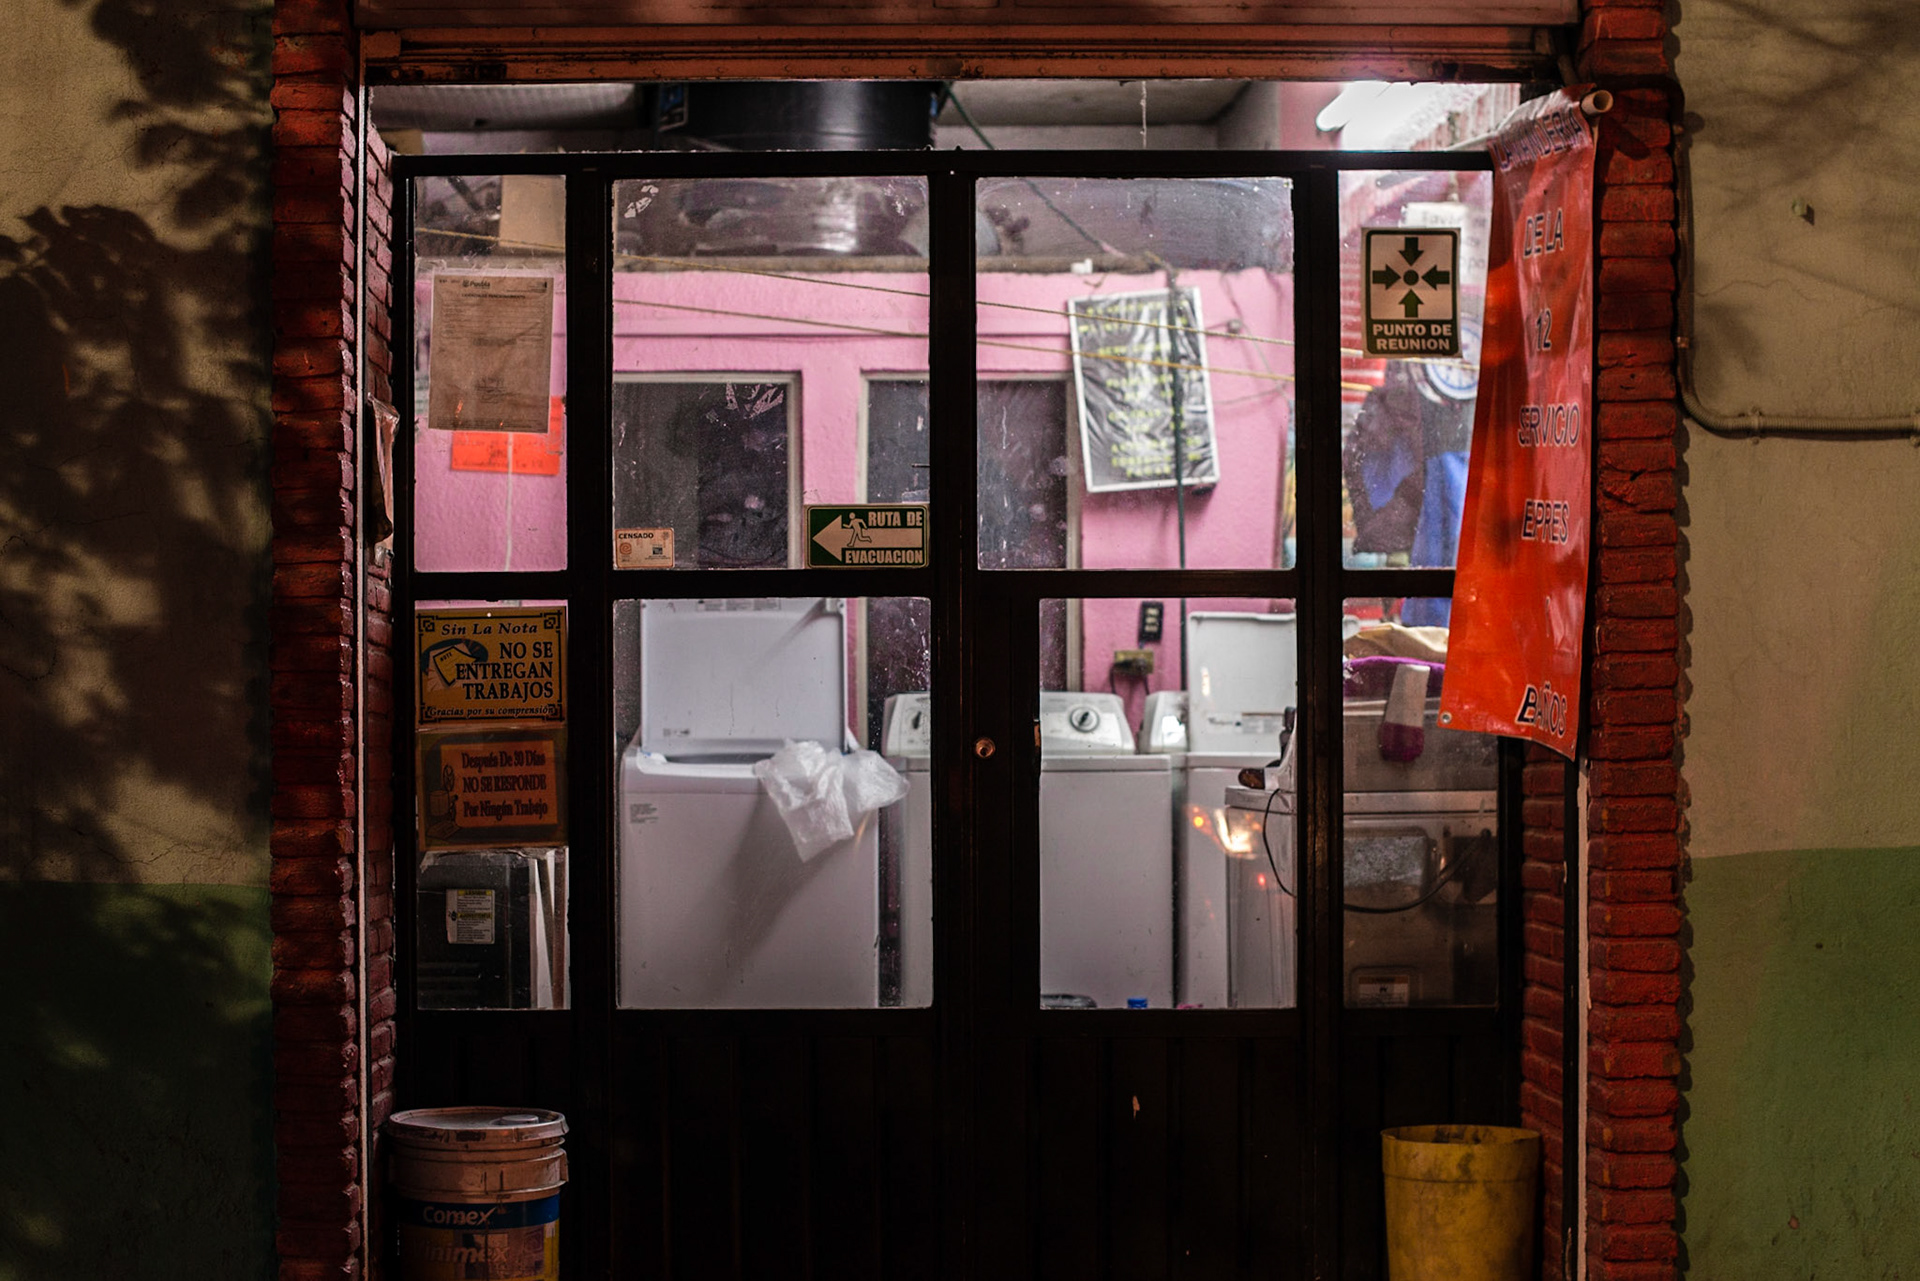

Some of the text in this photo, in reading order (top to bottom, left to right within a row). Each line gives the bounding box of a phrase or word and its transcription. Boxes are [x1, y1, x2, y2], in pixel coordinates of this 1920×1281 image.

[1545, 208, 1564, 252] LA
[1372, 323, 1453, 337] PUNTO DE
[1536, 308, 1553, 351] 12
[1376, 338, 1450, 350] REUNION
[867, 511, 924, 527] RUTA DE
[618, 532, 654, 540] CENSADO
[844, 549, 924, 564] EVACUACION
[441, 622, 538, 635] Sin La Nota
[499, 641, 553, 659] NO SE
[455, 662, 553, 680] ENTREGAN
[462, 681, 554, 703] TRABAJOS
[430, 707, 464, 717] Gracias
[467, 709, 482, 719] por
[498, 705, 555, 718] comprensión
[1514, 680, 1567, 738] BAÑOS
[461, 752, 499, 773] Después
[499, 751, 513, 767] De
[462, 774, 547, 793] NO SE RESPONDE
[463, 801, 479, 817] Por
[514, 798, 549, 820] Trabajo
[422, 1205, 497, 1226] Comex
